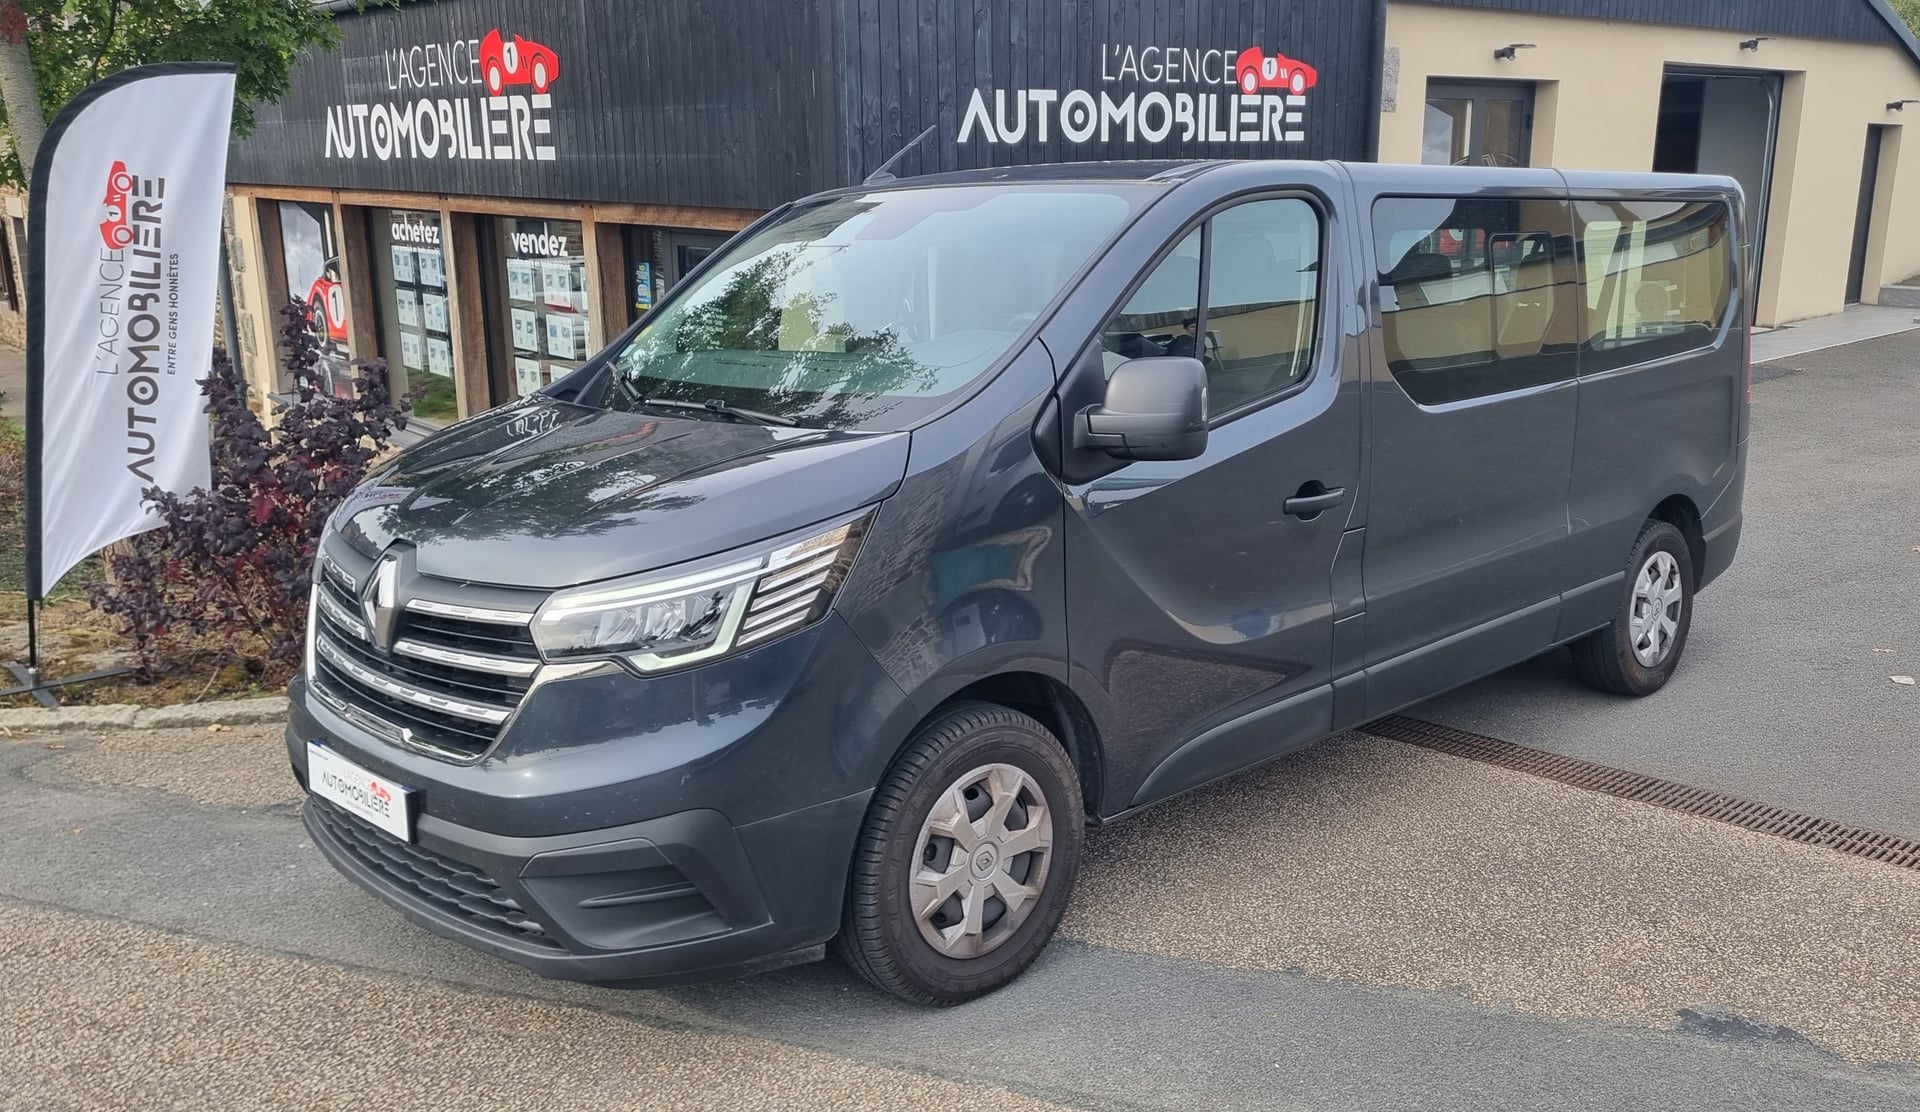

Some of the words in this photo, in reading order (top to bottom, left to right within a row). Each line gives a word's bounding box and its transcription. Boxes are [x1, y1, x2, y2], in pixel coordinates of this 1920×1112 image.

[385, 39, 483, 90] L'AGENCE
[1102, 43, 1238, 84] L'AGENCE
[391, 213, 440, 244] achetez
[510, 221, 569, 257] vendez
[166, 253, 179, 309] HONNÊTES
[96, 248, 124, 375] L'AGENCE
[168, 311, 178, 339] GENS
[167, 342, 177, 375] ENTRE
